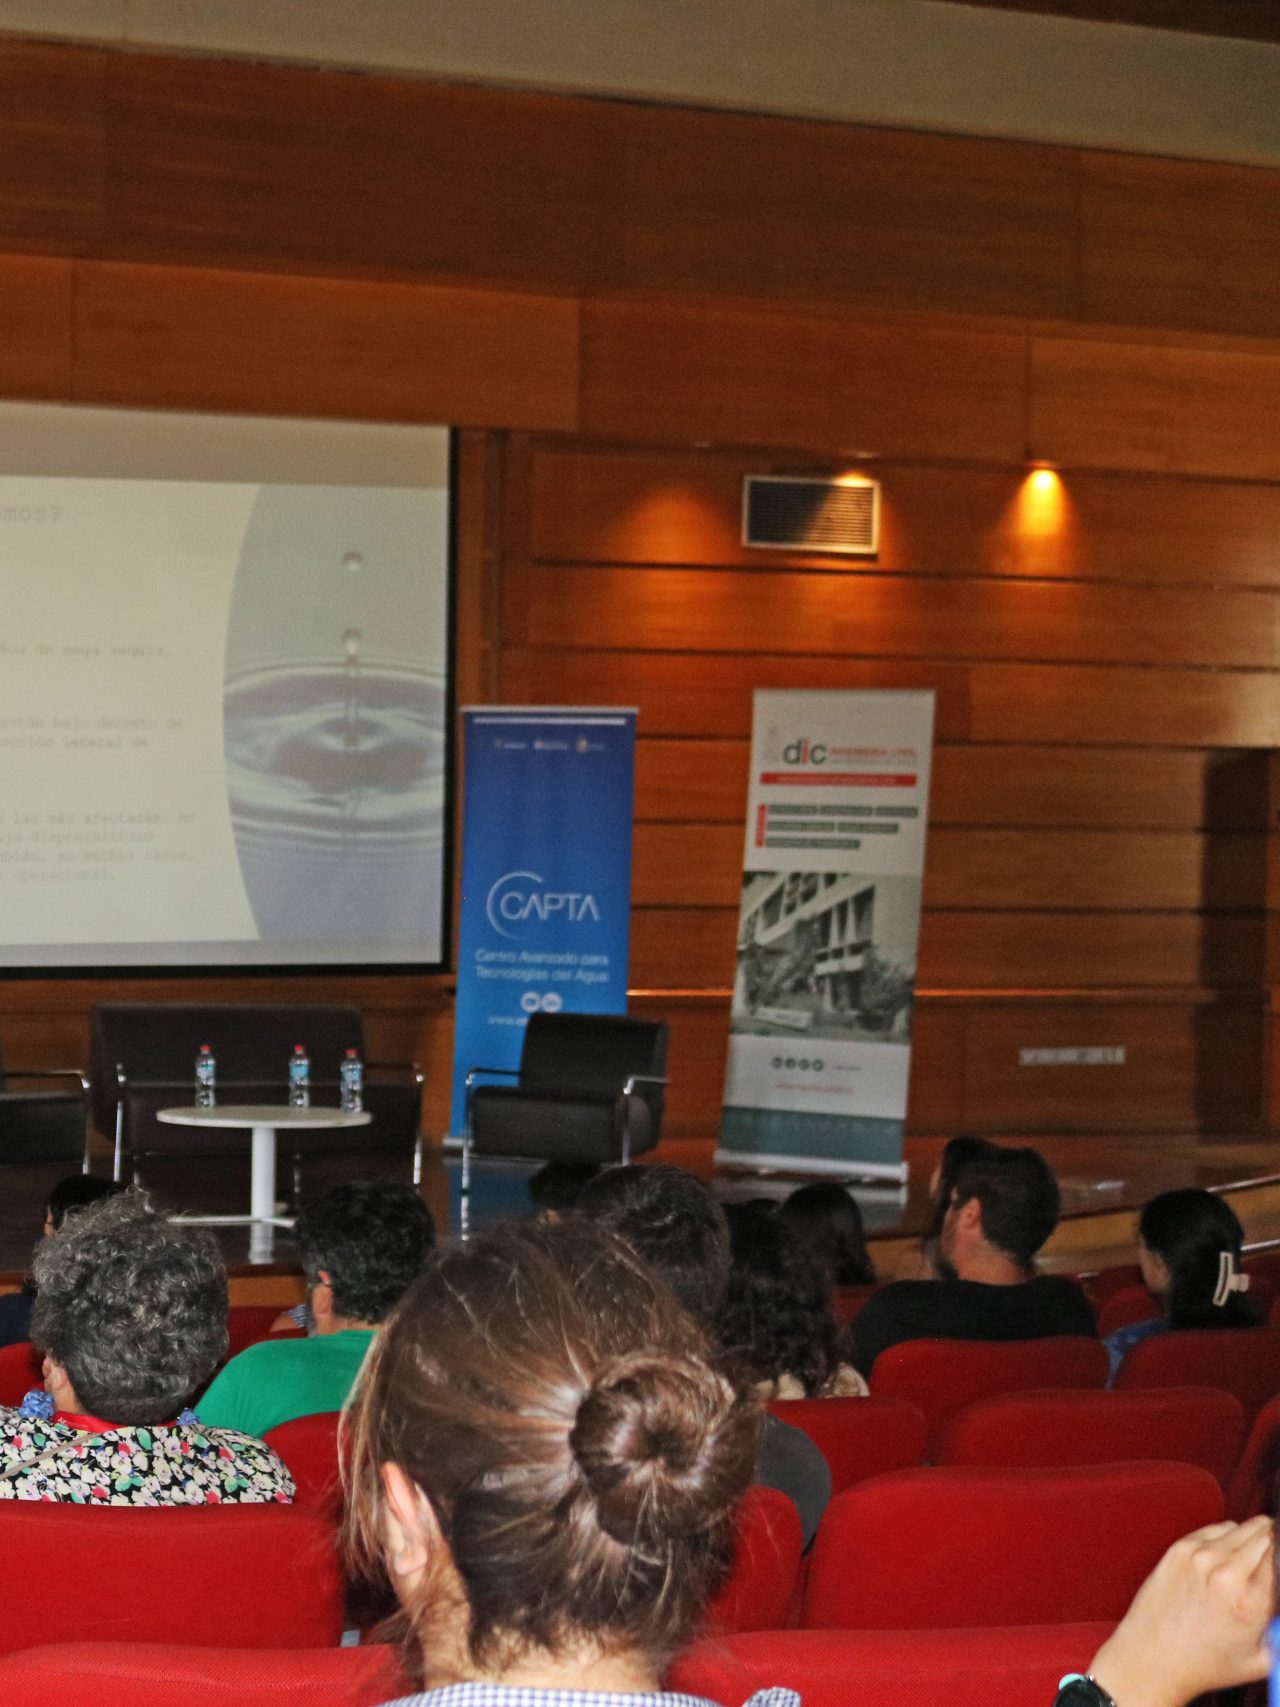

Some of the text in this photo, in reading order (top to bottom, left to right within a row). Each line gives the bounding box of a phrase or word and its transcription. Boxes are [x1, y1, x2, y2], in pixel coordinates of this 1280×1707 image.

[782, 735, 827, 765] dic
[498, 891, 601, 922] CAPTA
[575, 968, 609, 985] Agua
